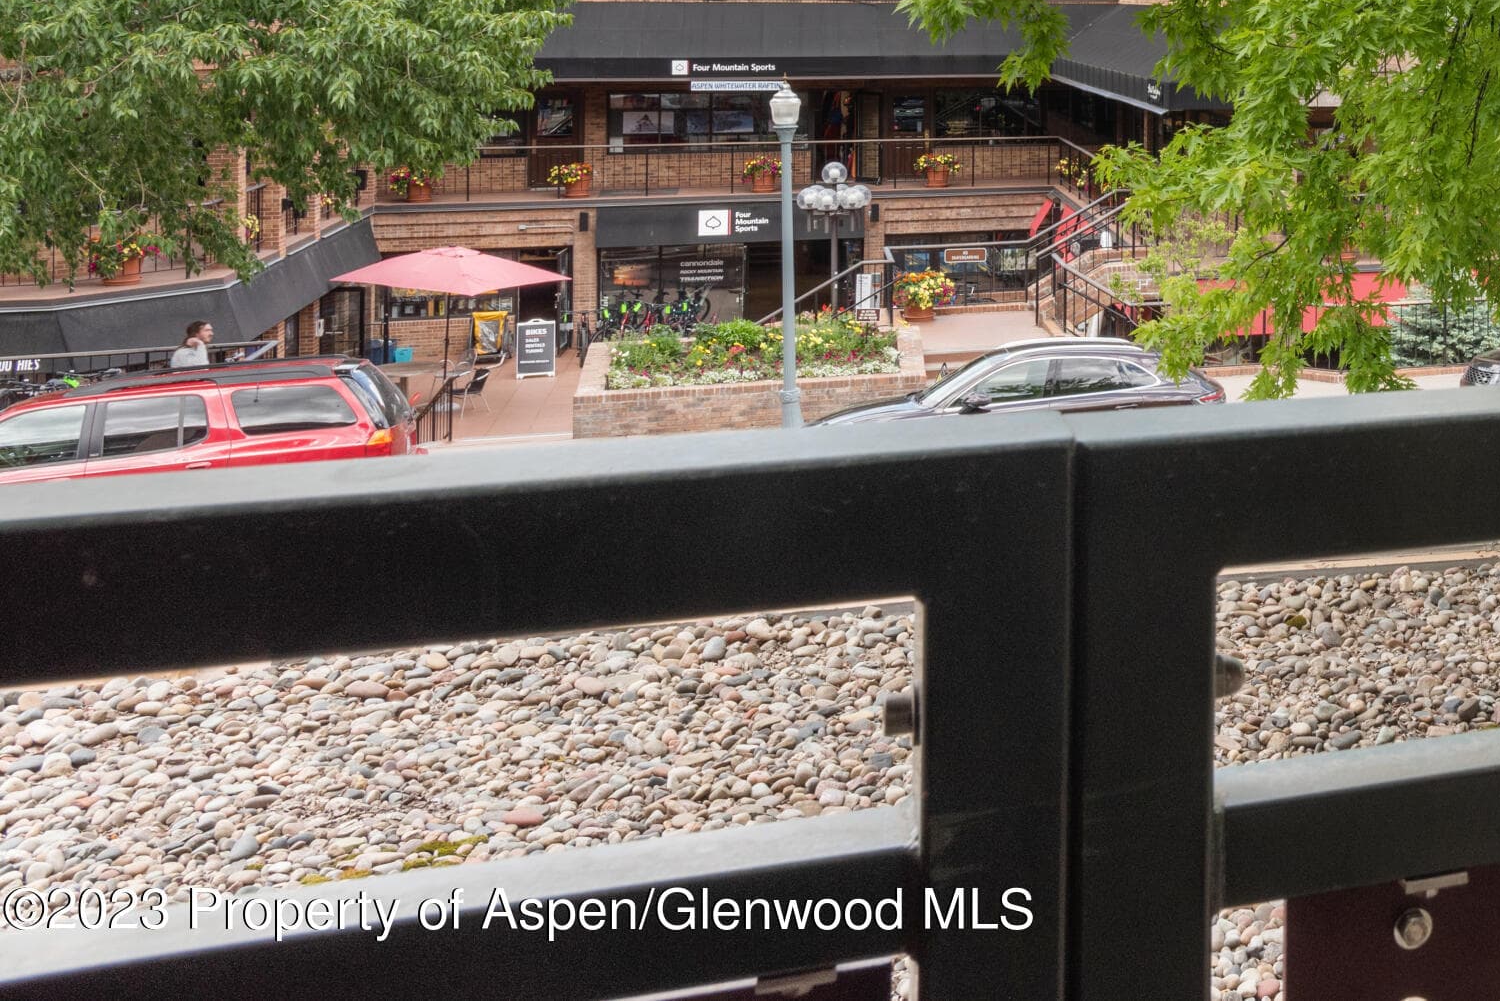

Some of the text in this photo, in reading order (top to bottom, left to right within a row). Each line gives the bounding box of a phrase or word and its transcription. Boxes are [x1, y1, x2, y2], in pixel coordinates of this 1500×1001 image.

[692, 63, 776, 72] Four Mountain Sports
[692, 82, 783, 90] ASPEN WHITEWATER RAFTIN
[735, 217, 769, 225] Mountain
[735, 225, 758, 233] Sports
